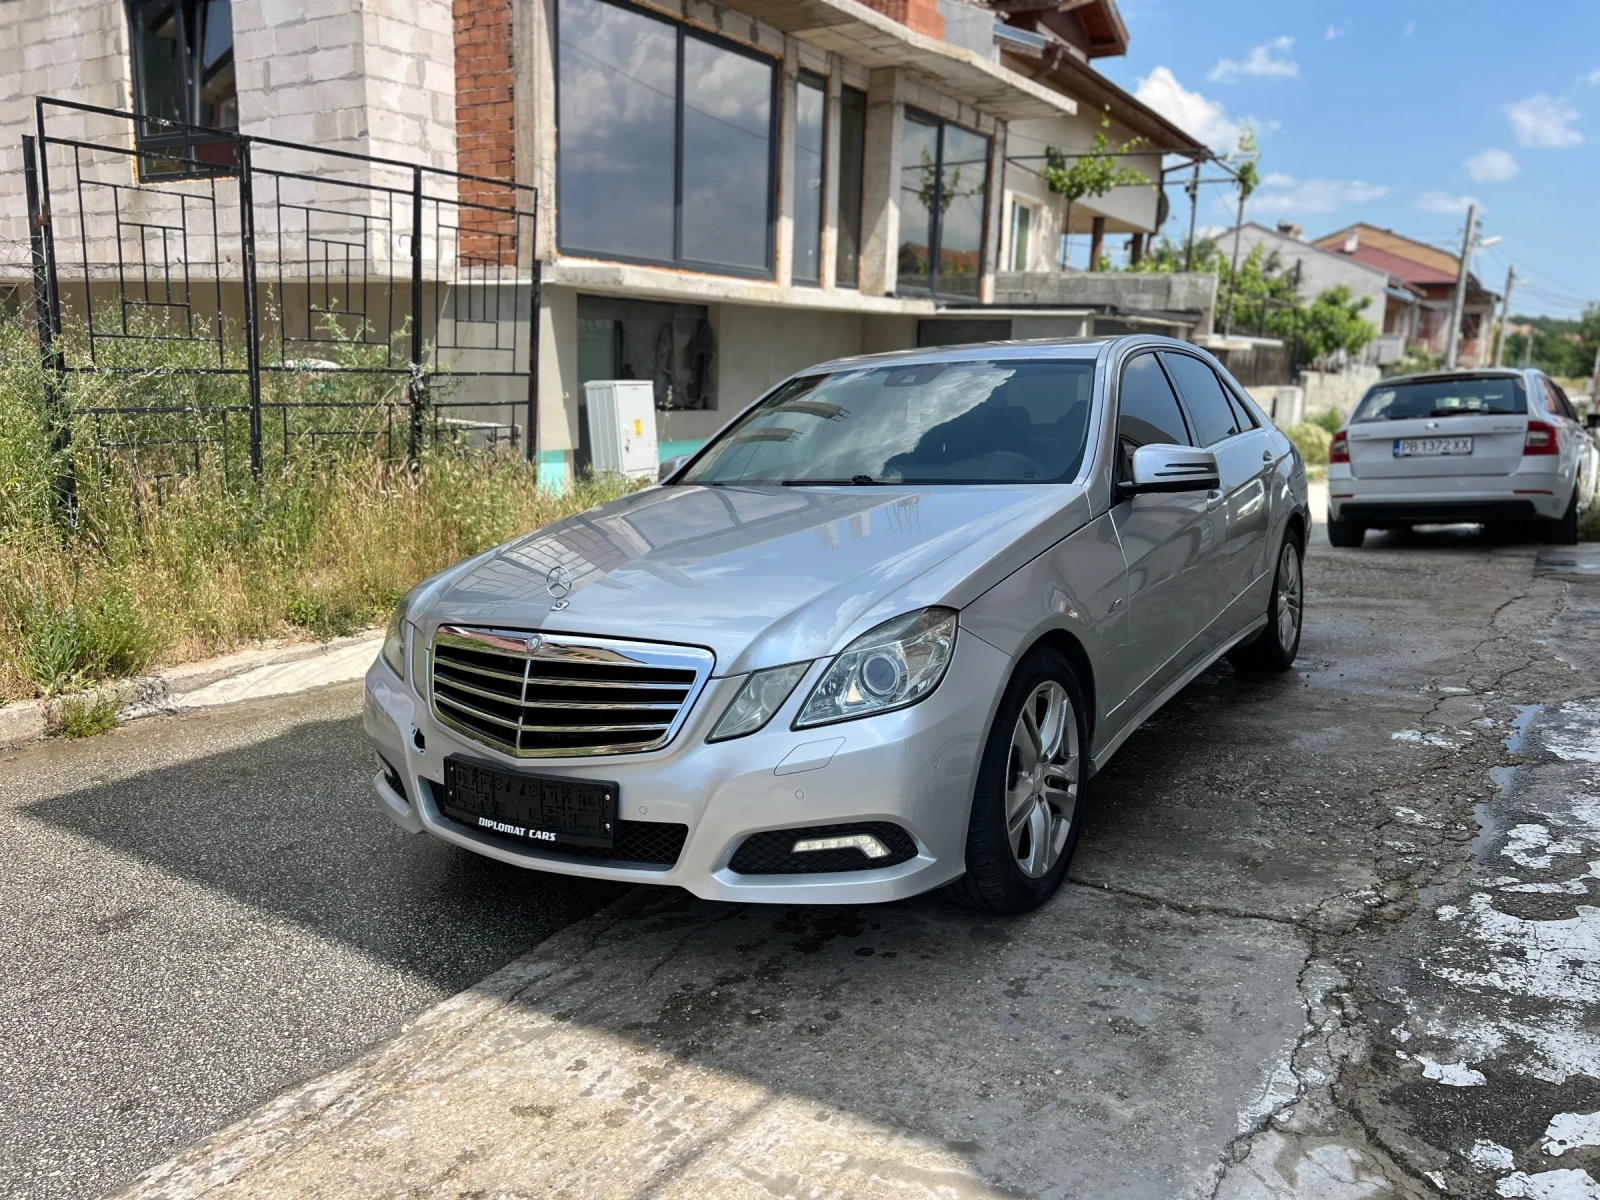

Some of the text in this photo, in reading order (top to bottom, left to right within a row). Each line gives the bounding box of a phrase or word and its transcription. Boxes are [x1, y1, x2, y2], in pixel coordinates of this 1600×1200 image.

[1402, 441, 1418, 453] PB
[1422, 440, 1450, 452] 1372
[1453, 438, 1469, 450] XX
[478, 817, 557, 841] DIPLOMAT CARS
